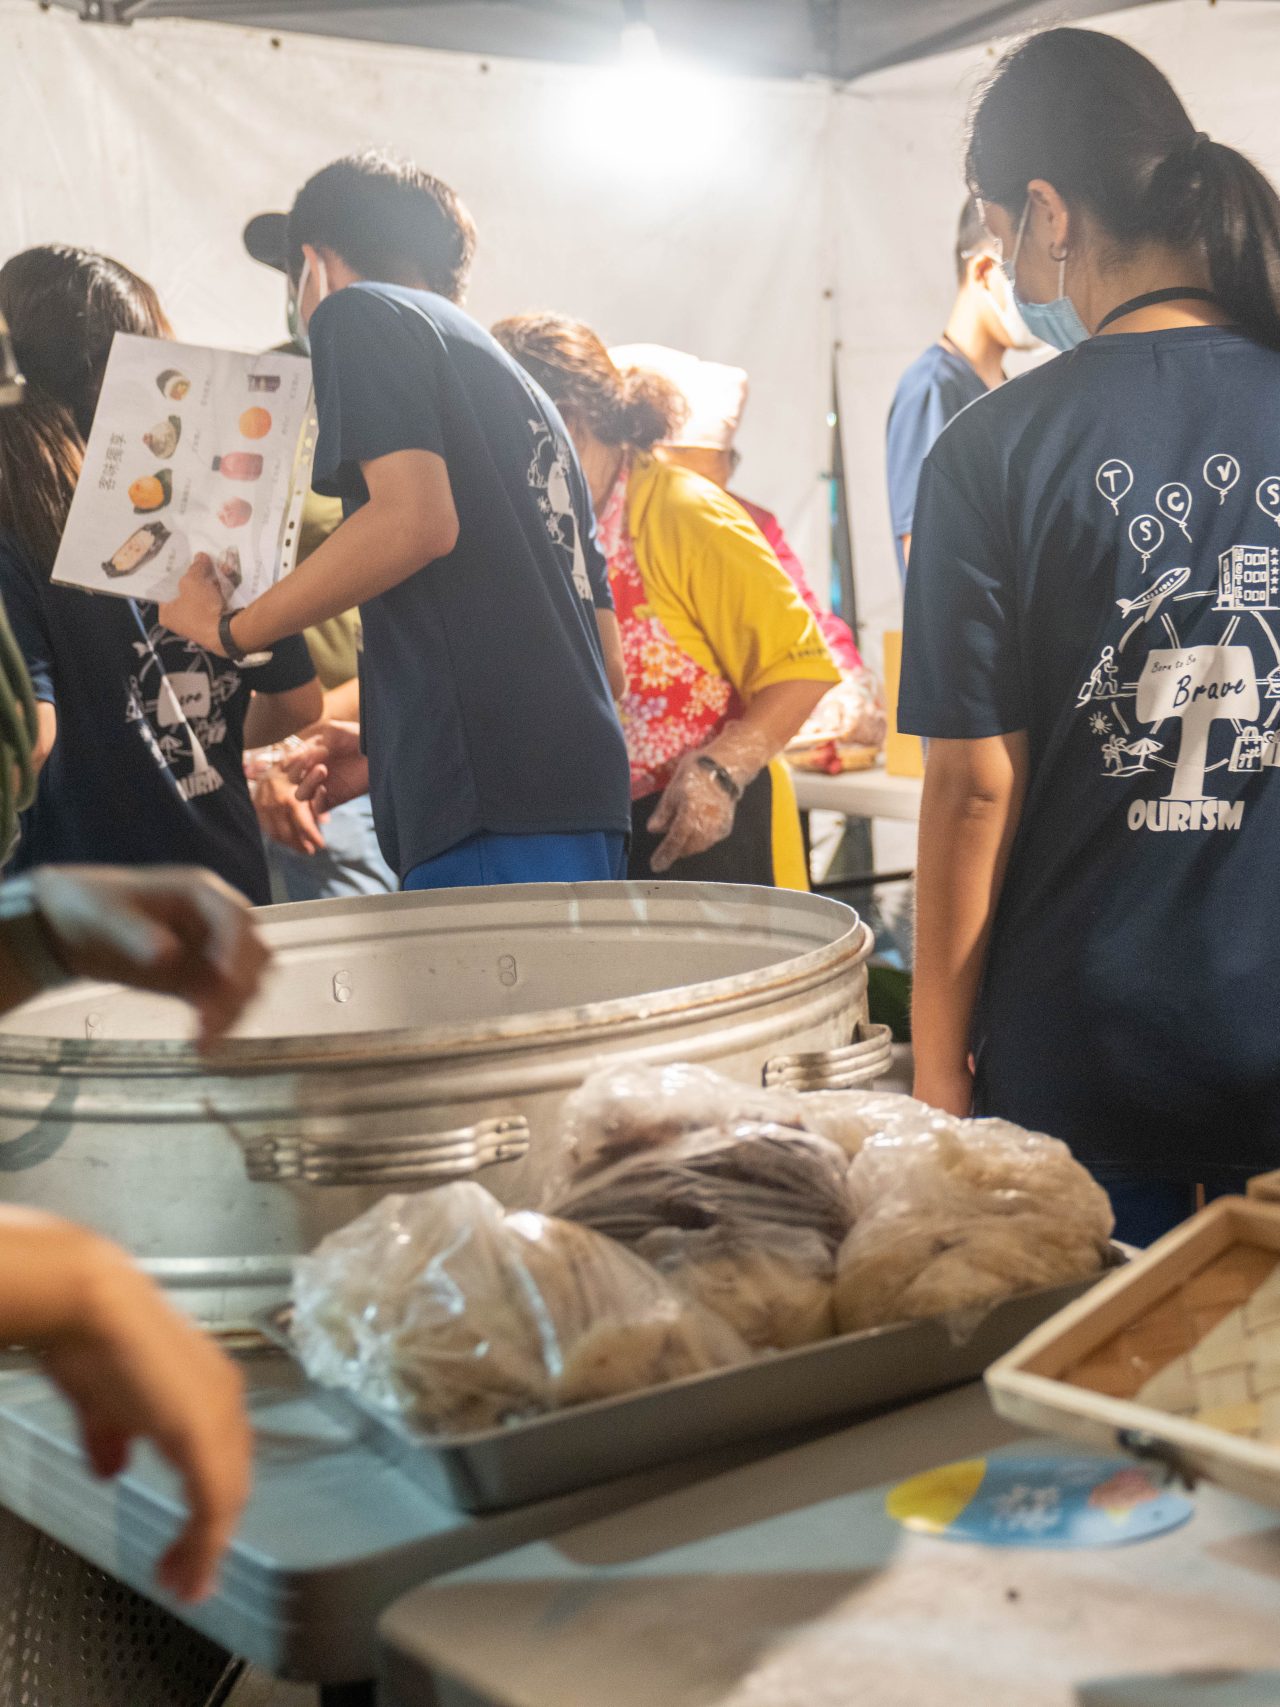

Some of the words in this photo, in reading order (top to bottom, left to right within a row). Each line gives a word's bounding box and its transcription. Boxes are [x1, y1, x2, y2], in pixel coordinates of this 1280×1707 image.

[1103, 470, 1122, 492] T
[1139, 520, 1152, 541] S
[1166, 491, 1184, 511] C
[1216, 461, 1232, 481] V
[1267, 483, 1280, 505] S
[1175, 660, 1184, 669] to
[1172, 674, 1246, 708] Brave
